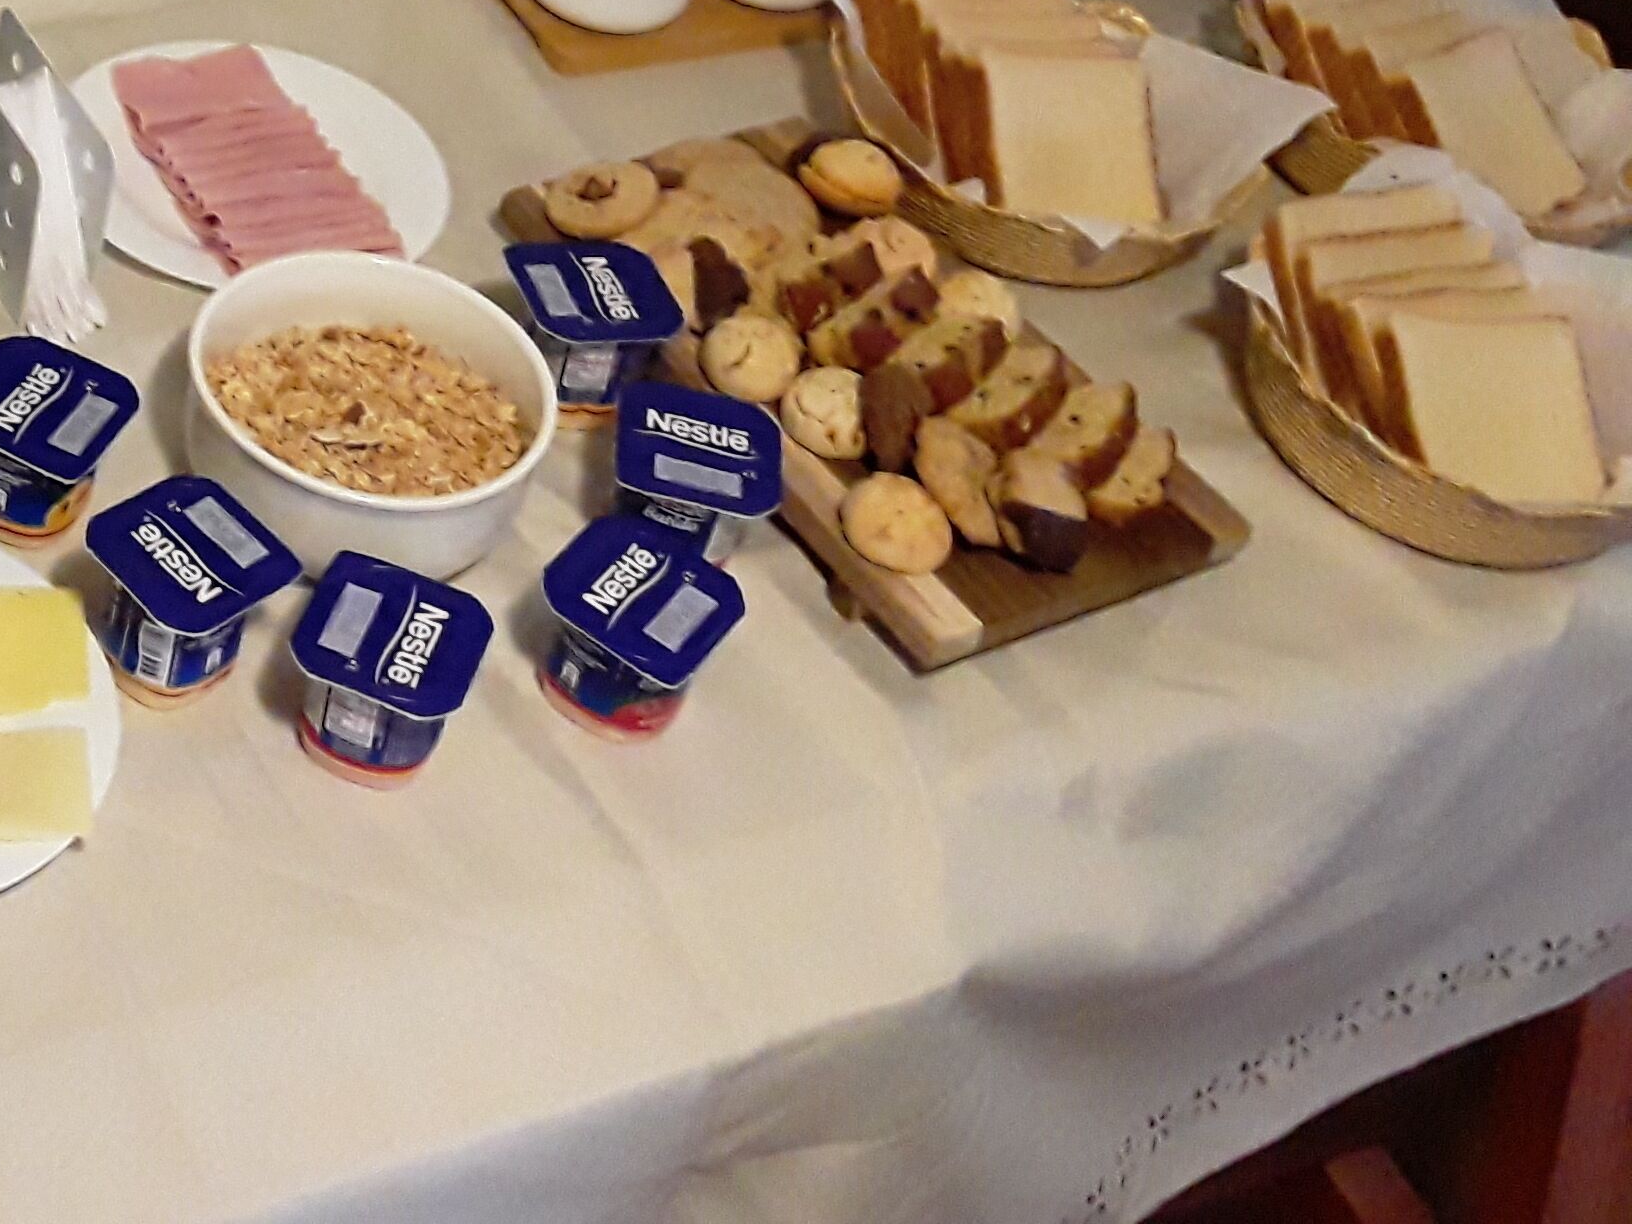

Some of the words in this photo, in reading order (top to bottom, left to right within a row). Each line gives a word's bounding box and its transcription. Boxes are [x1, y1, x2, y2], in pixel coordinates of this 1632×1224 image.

[581, 255, 639, 322] Nestlé
[645, 408, 750, 453] Nestlé
[130, 521, 224, 604] Nestlé
[582, 544, 658, 616] Nestlé
[386, 602, 450, 690] Nestlé
